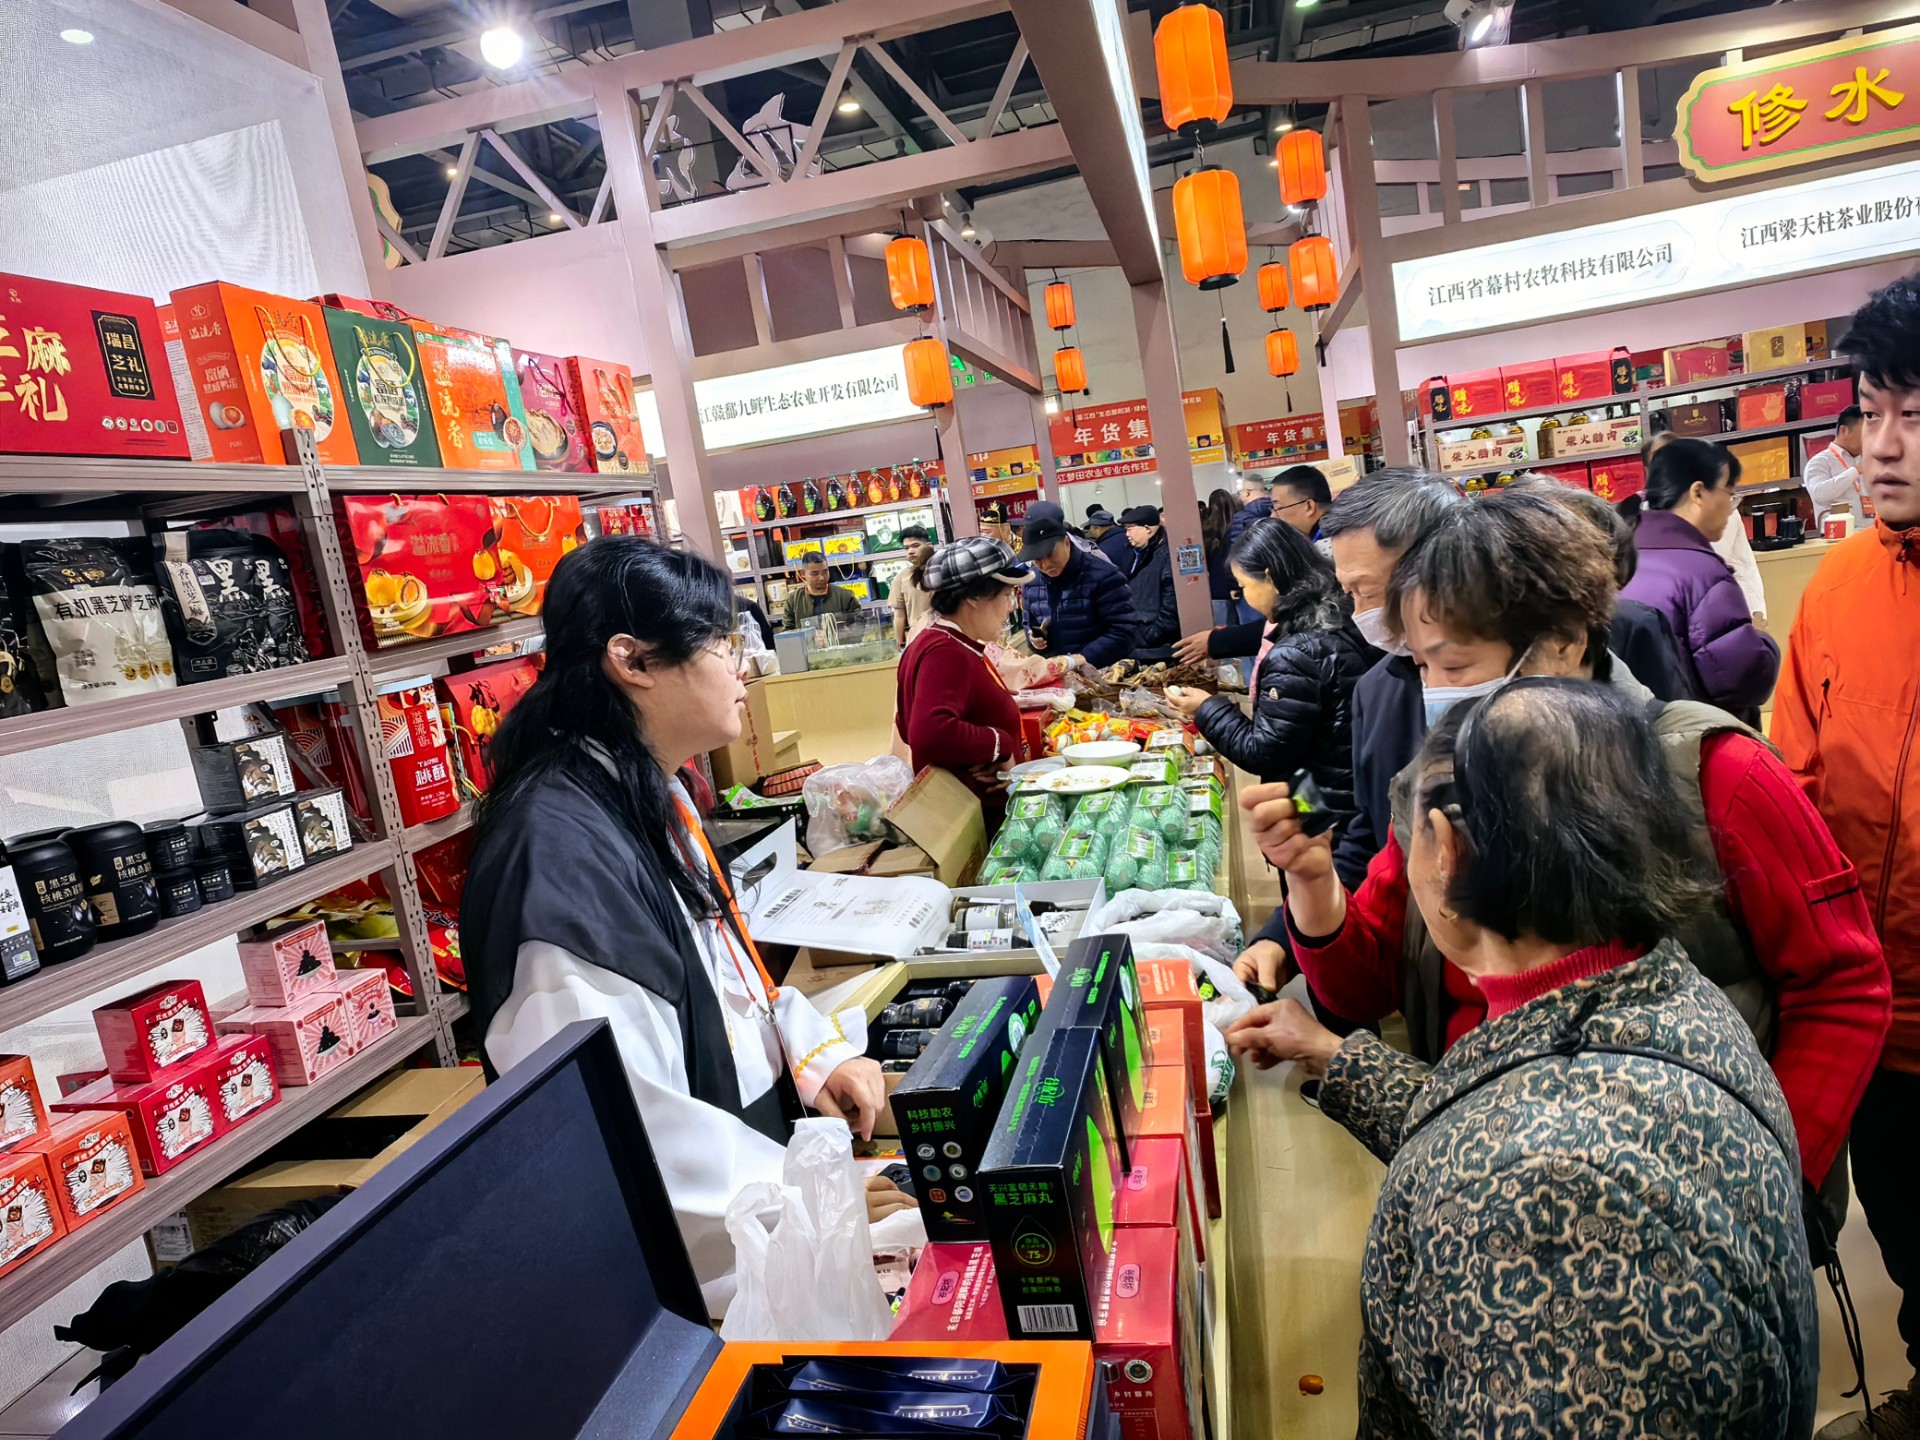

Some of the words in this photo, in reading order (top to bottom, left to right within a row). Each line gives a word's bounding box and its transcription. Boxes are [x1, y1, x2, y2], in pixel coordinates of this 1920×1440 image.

[1728, 66, 1905, 151] 修水
[105, 332, 136, 351] 瑞昌
[111, 353, 143, 374] 芝礼
[1073, 418, 1149, 447] 年货集
[205, 558, 250, 603] 黑
[54, 594, 134, 621] 有机黑芝麻
[993, 1191, 1054, 1206] 黑芝麻丸
